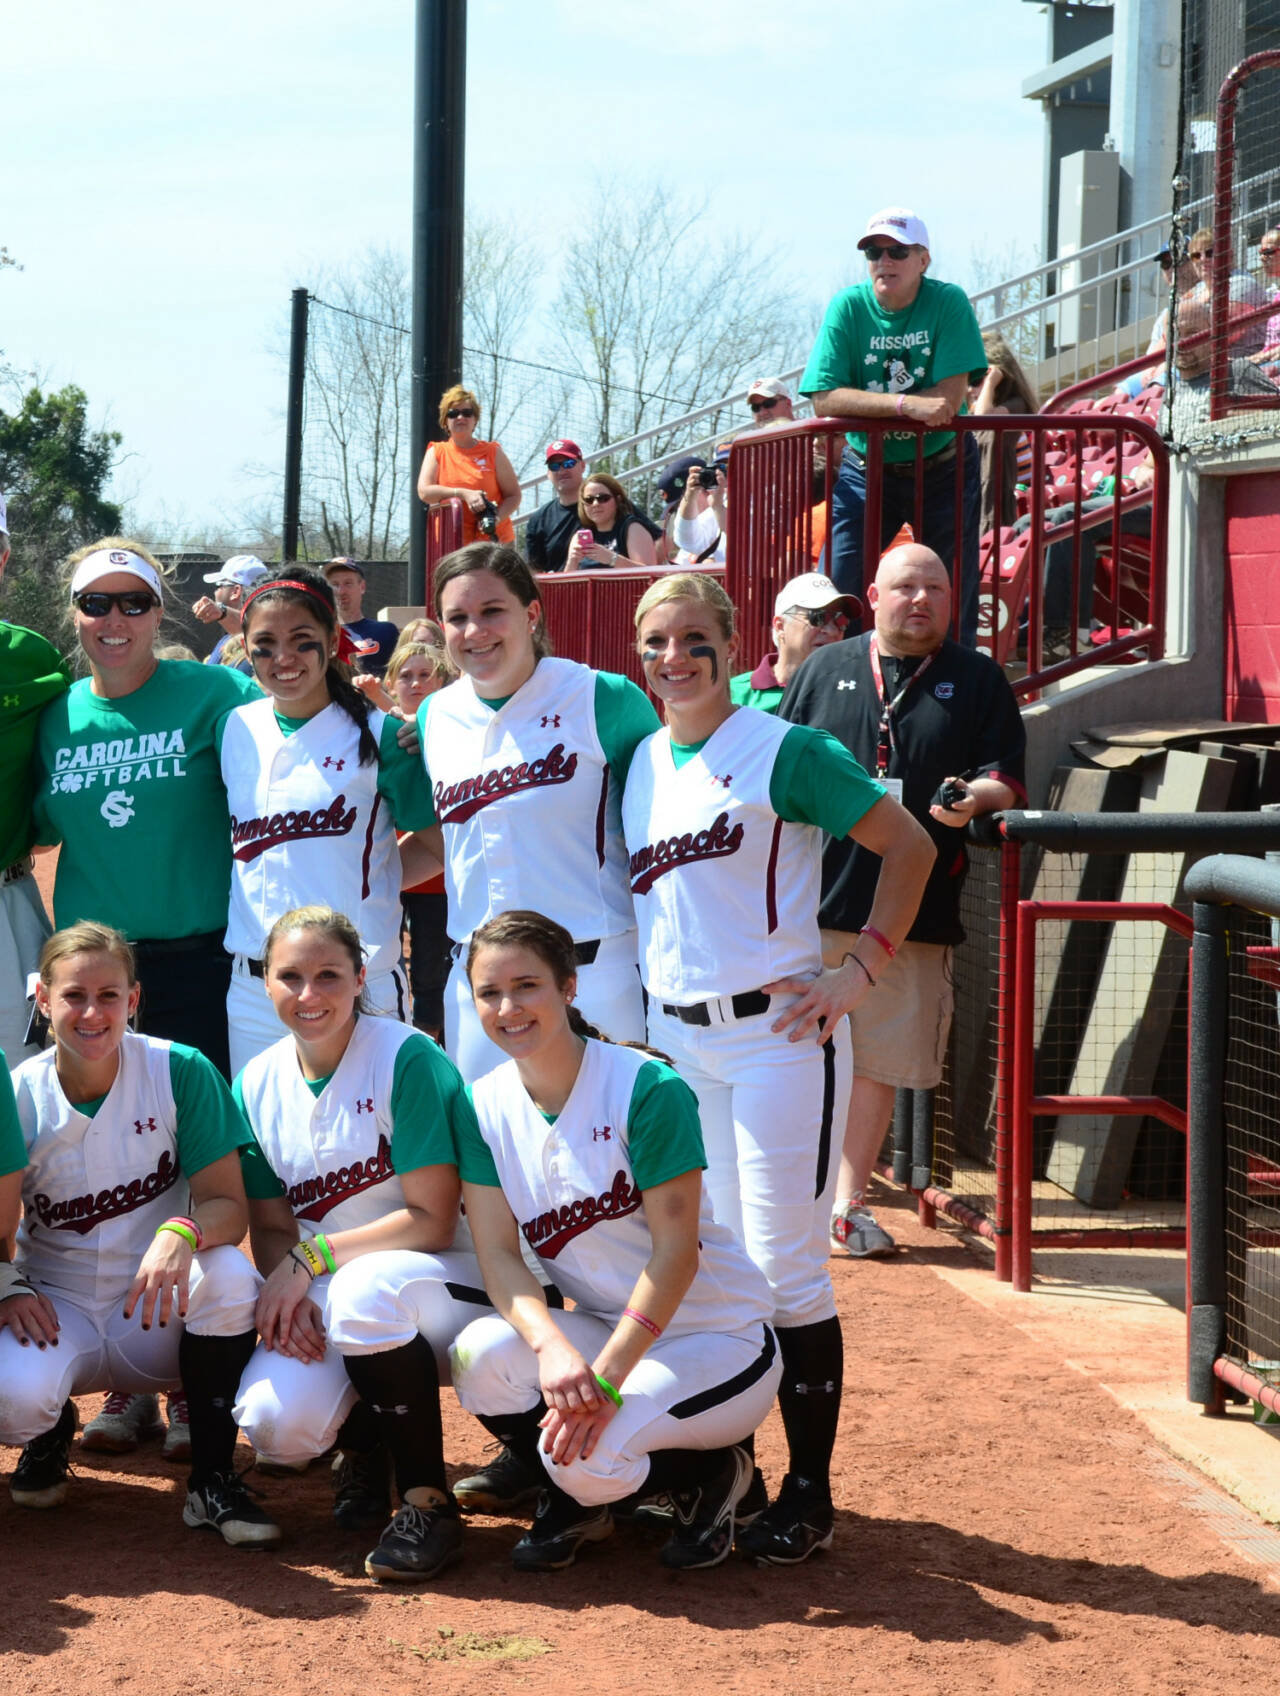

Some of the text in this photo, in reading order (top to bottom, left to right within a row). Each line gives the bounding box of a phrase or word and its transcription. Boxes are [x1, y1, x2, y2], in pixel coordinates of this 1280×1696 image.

[870, 336, 902, 349] KISS
[55, 728, 186, 771] CAROLINA
[278, 1134, 395, 1217] amecock
